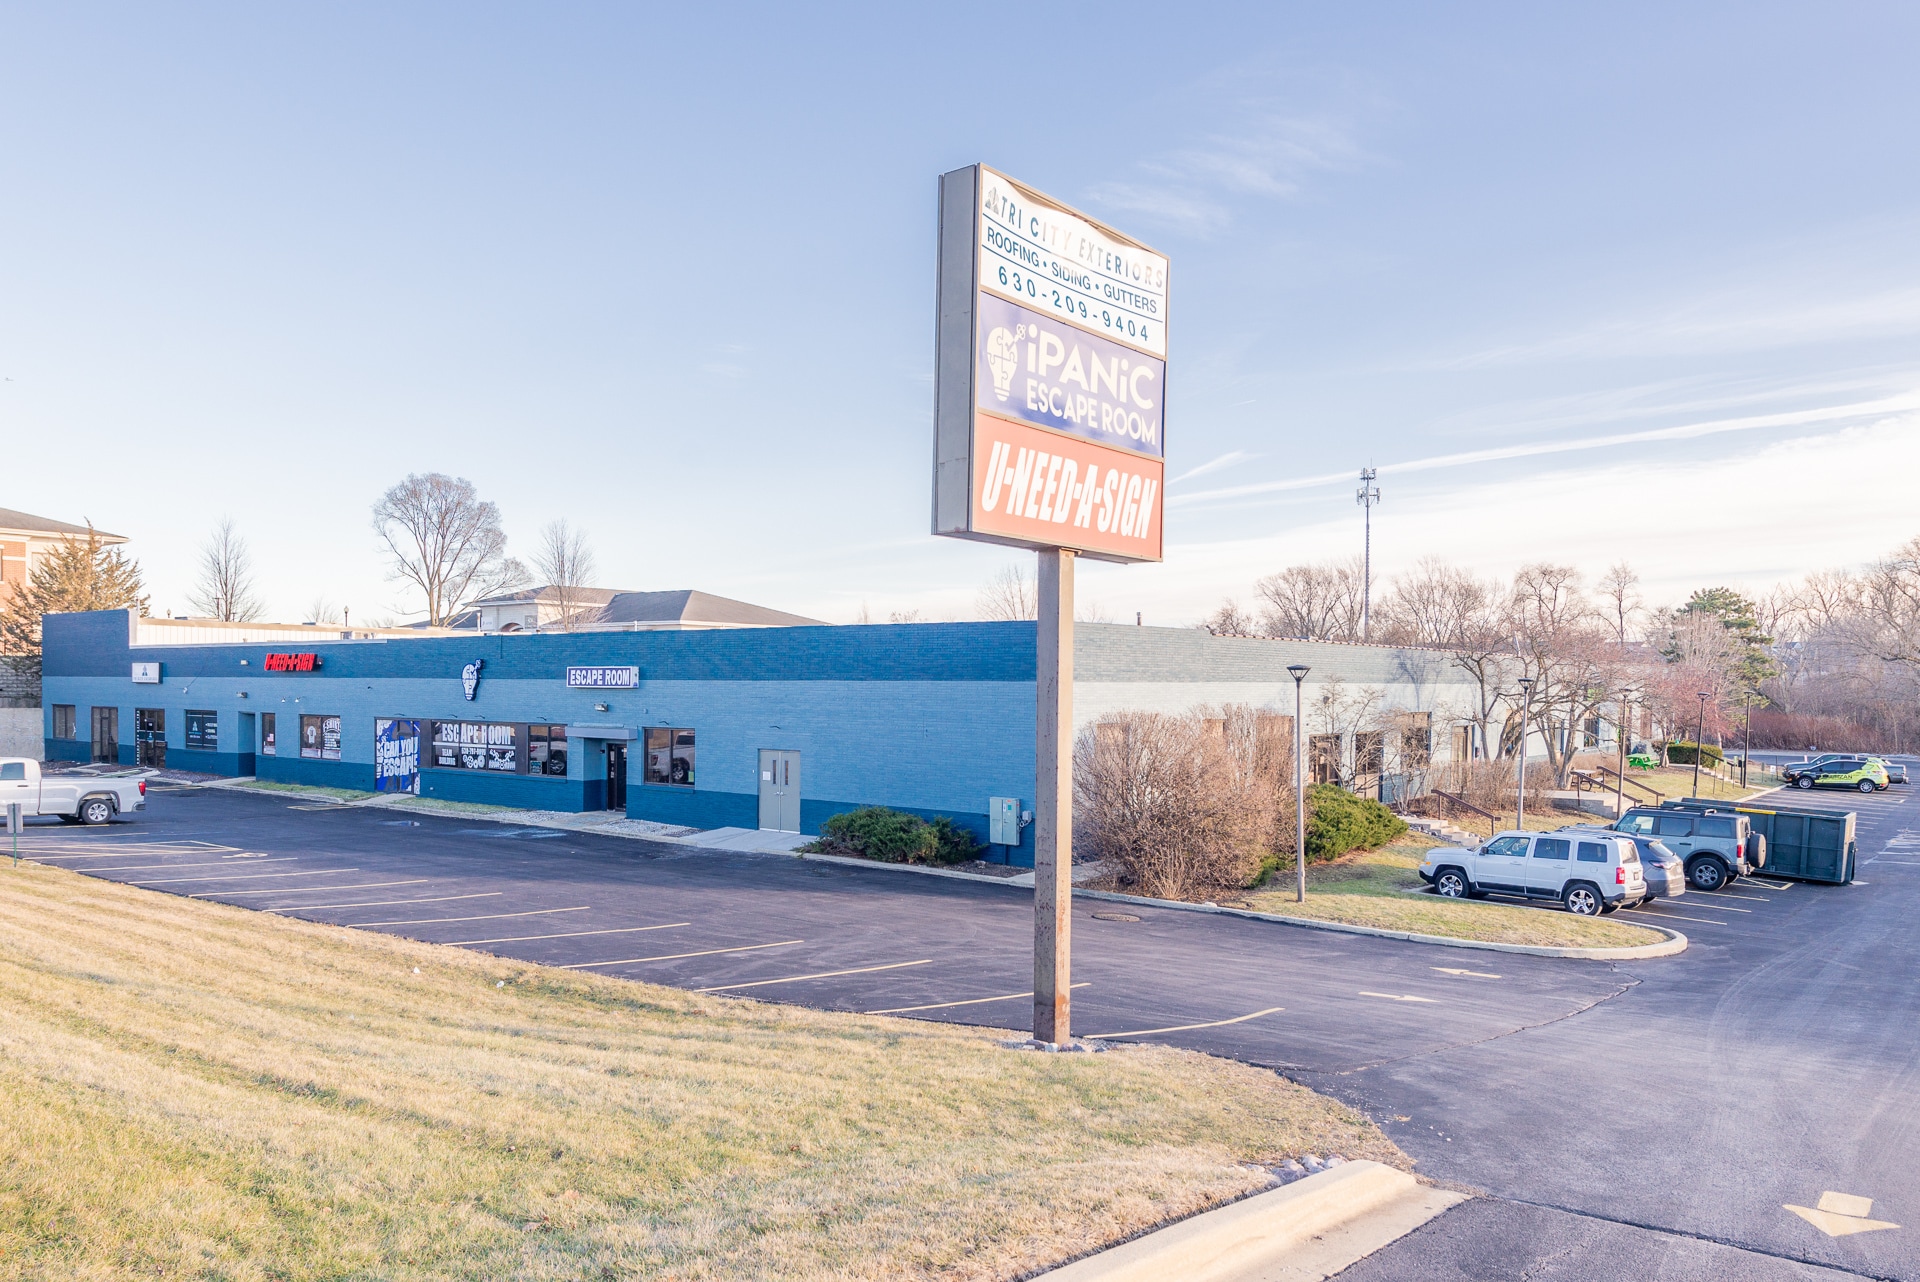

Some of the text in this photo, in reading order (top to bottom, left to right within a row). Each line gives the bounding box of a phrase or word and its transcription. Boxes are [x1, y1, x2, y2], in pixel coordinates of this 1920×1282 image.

[1001, 196, 1163, 288] TRI CITY EXTERIORS
[987, 226, 1157, 314] ROOFING SIDING GUTTERS
[998, 265, 1149, 342] 630-209-9404
[1026, 377, 1156, 446] ESCAPE ROOM
[981, 440, 1158, 540] U-NEED-A-SIGN
[570, 669, 630, 686] ESCAPE ROOM
[384, 737, 418, 758] CAN YOU
[441, 723, 511, 745] ESCAPE ROOM
[441, 748, 453, 757] TEAM
[384, 754, 418, 777] ESCAPE
